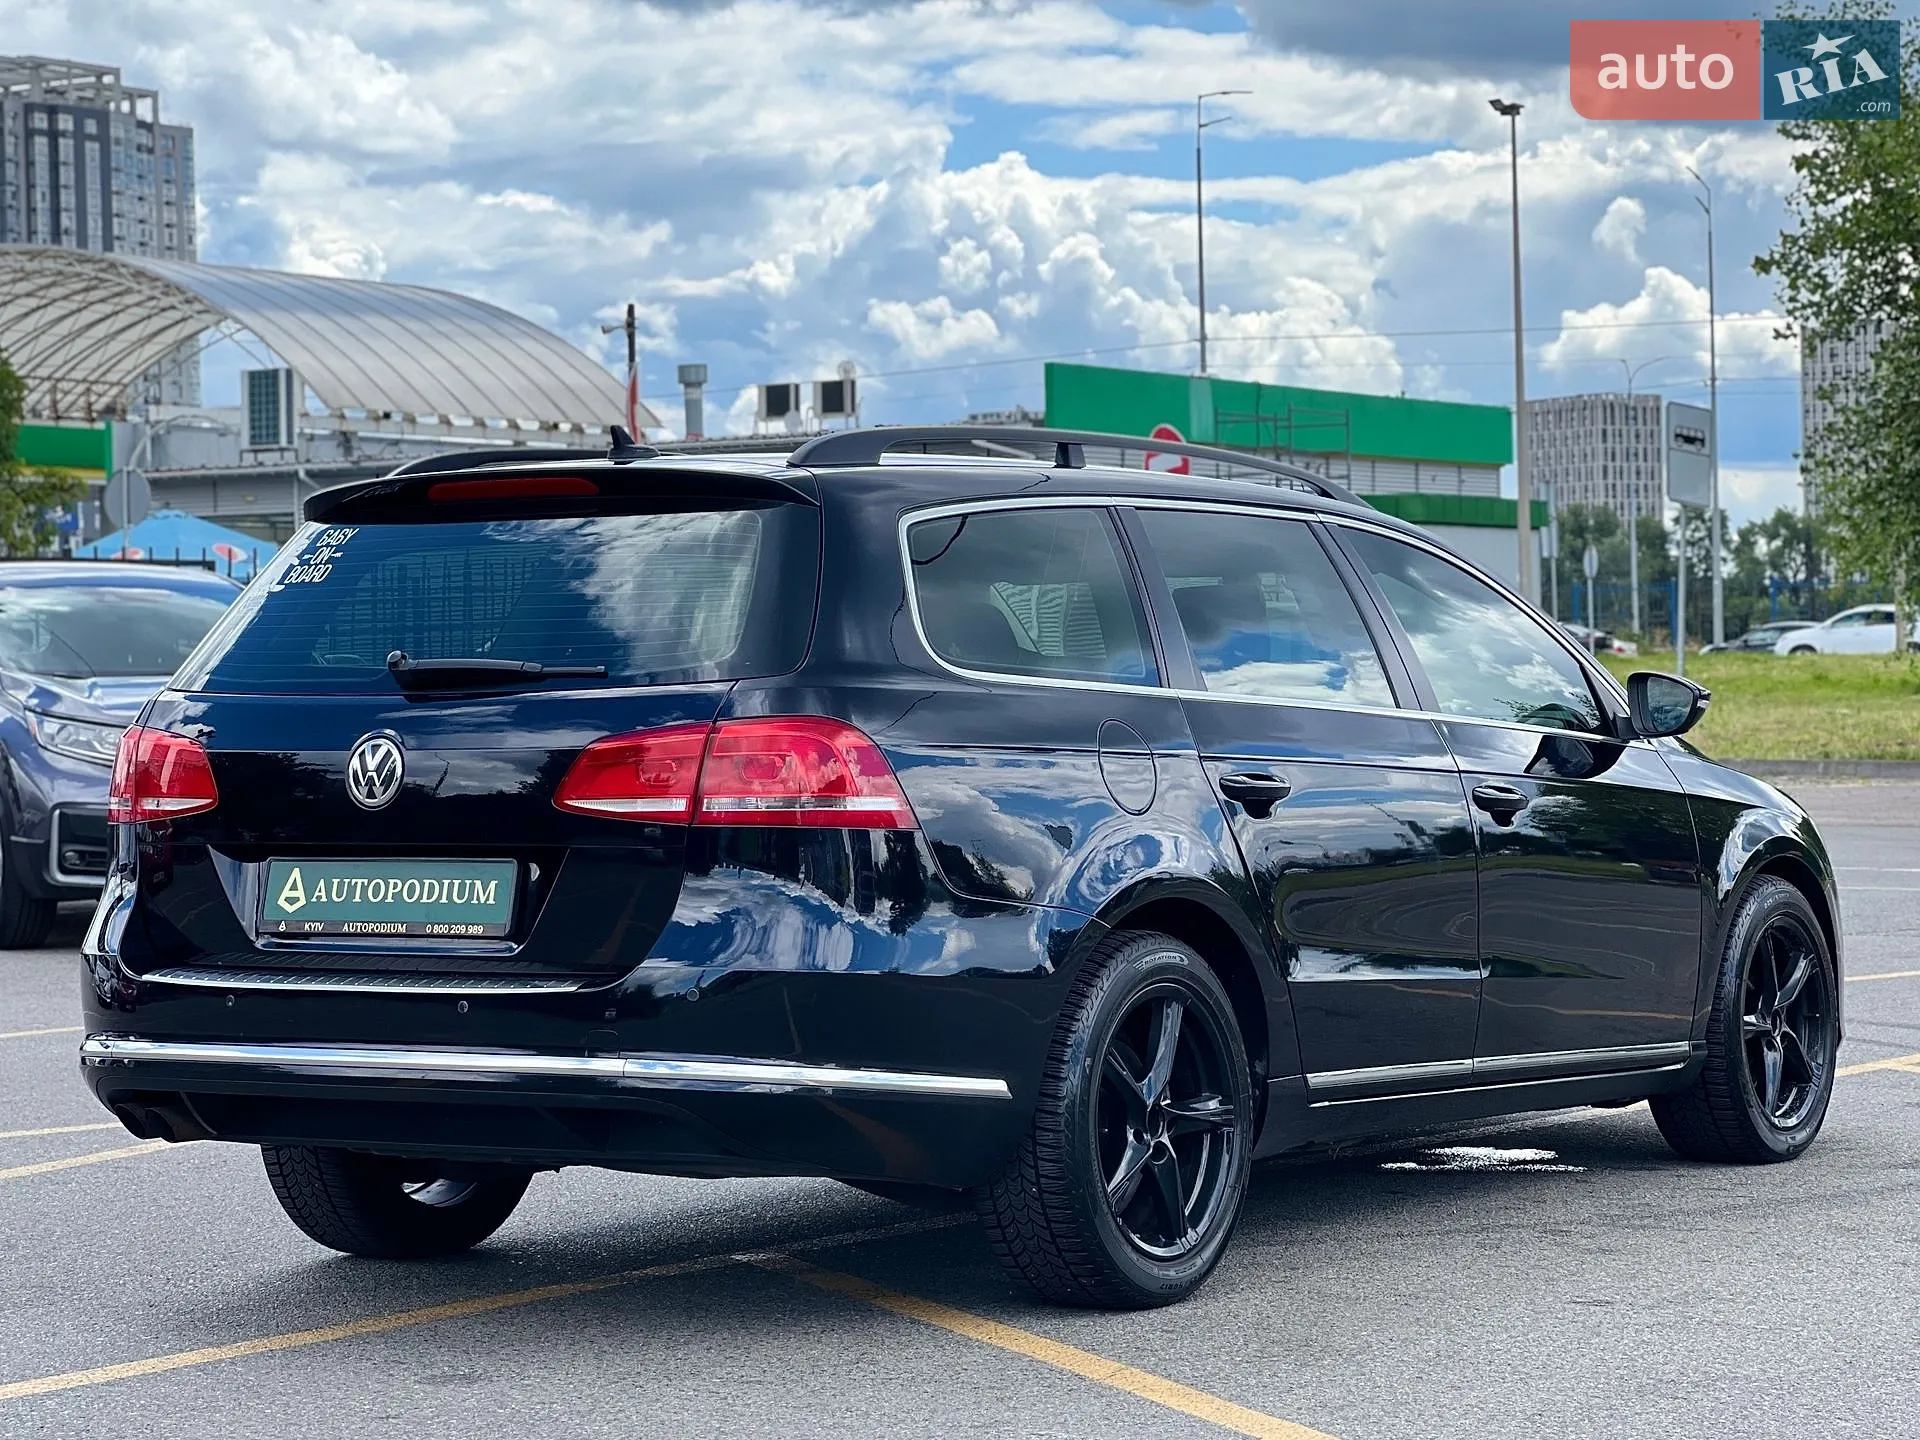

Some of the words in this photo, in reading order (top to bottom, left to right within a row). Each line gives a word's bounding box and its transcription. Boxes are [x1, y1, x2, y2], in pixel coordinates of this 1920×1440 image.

[284, 564, 333, 584] BOARD
[311, 878, 498, 904] AUTOPODIUM
[304, 922, 324, 932] KYIV
[342, 923, 407, 933] AUTOPODIUM
[426, 924, 432, 934] 0
[433, 924, 449, 934] 800
[450, 924, 466, 934] 209
[467, 925, 484, 934] 989
